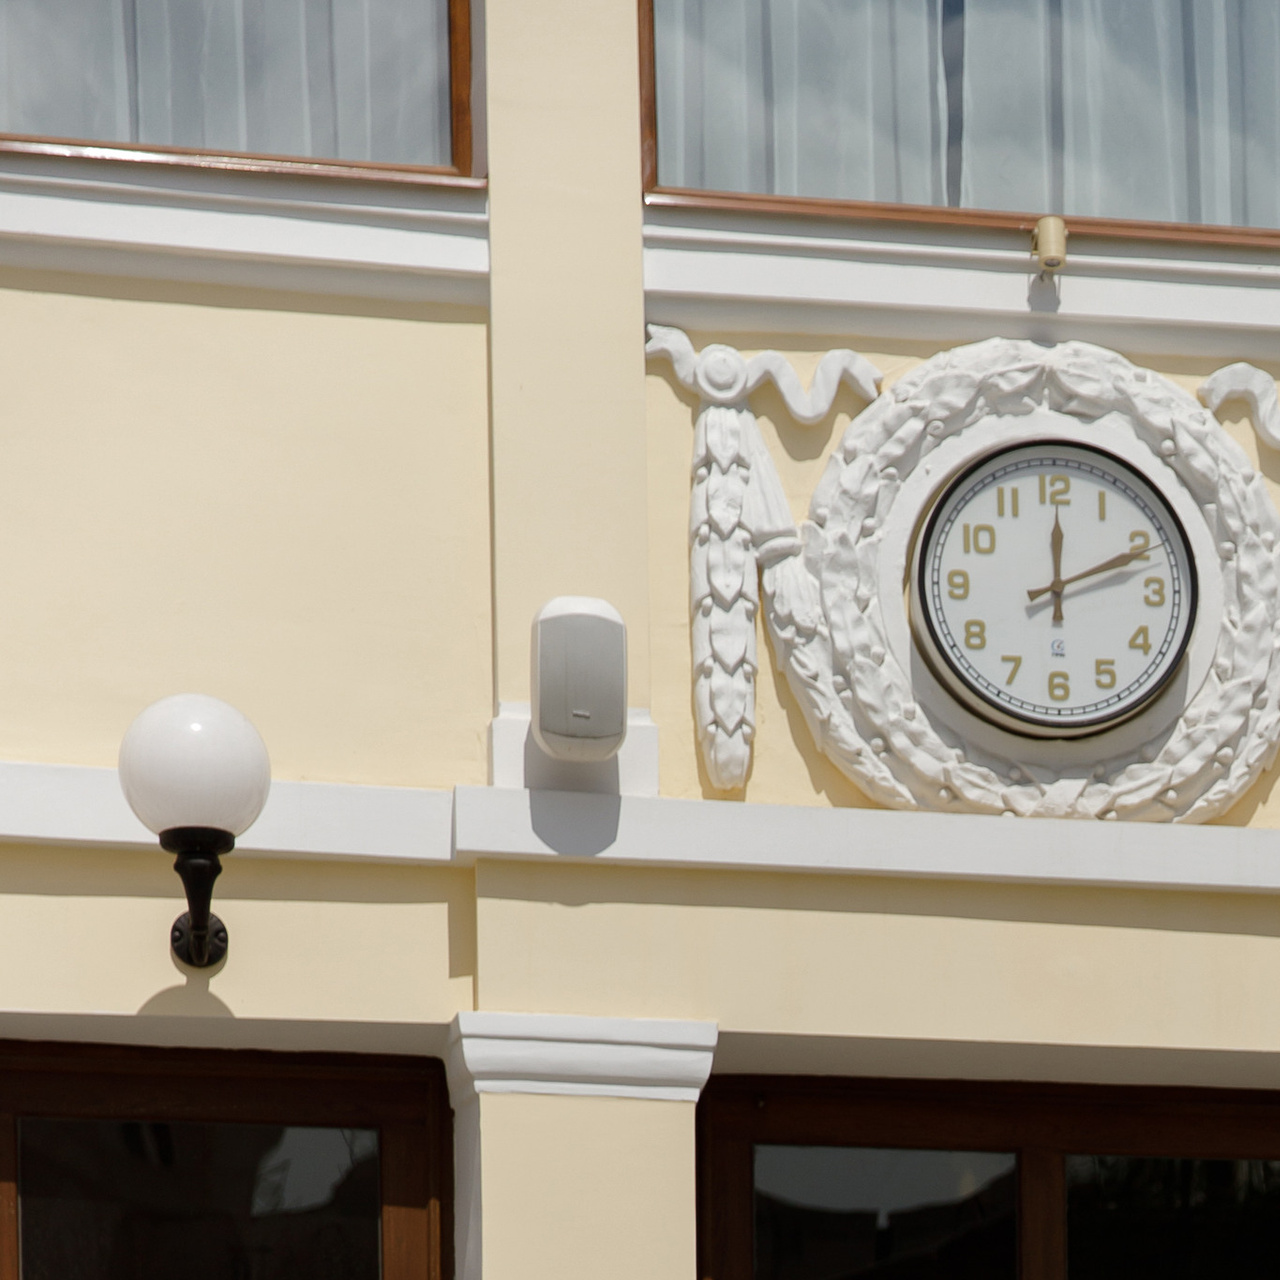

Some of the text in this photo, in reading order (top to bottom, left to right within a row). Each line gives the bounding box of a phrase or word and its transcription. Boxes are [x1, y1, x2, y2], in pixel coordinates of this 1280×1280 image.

[997, 486, 1019, 518] 11
[1039, 474, 1071, 505] 12
[1099, 490, 1106, 521] 1
[963, 523, 996, 554] 10
[1129, 530, 1151, 560] 2
[948, 569, 970, 599] 9
[1143, 577, 1166, 606] 3
[965, 619, 986, 650] 8
[1129, 625, 1152, 656] 4
[1001, 655, 1022, 685] 7
[1095, 659, 1116, 688] 5
[1048, 671, 1070, 701] 6
